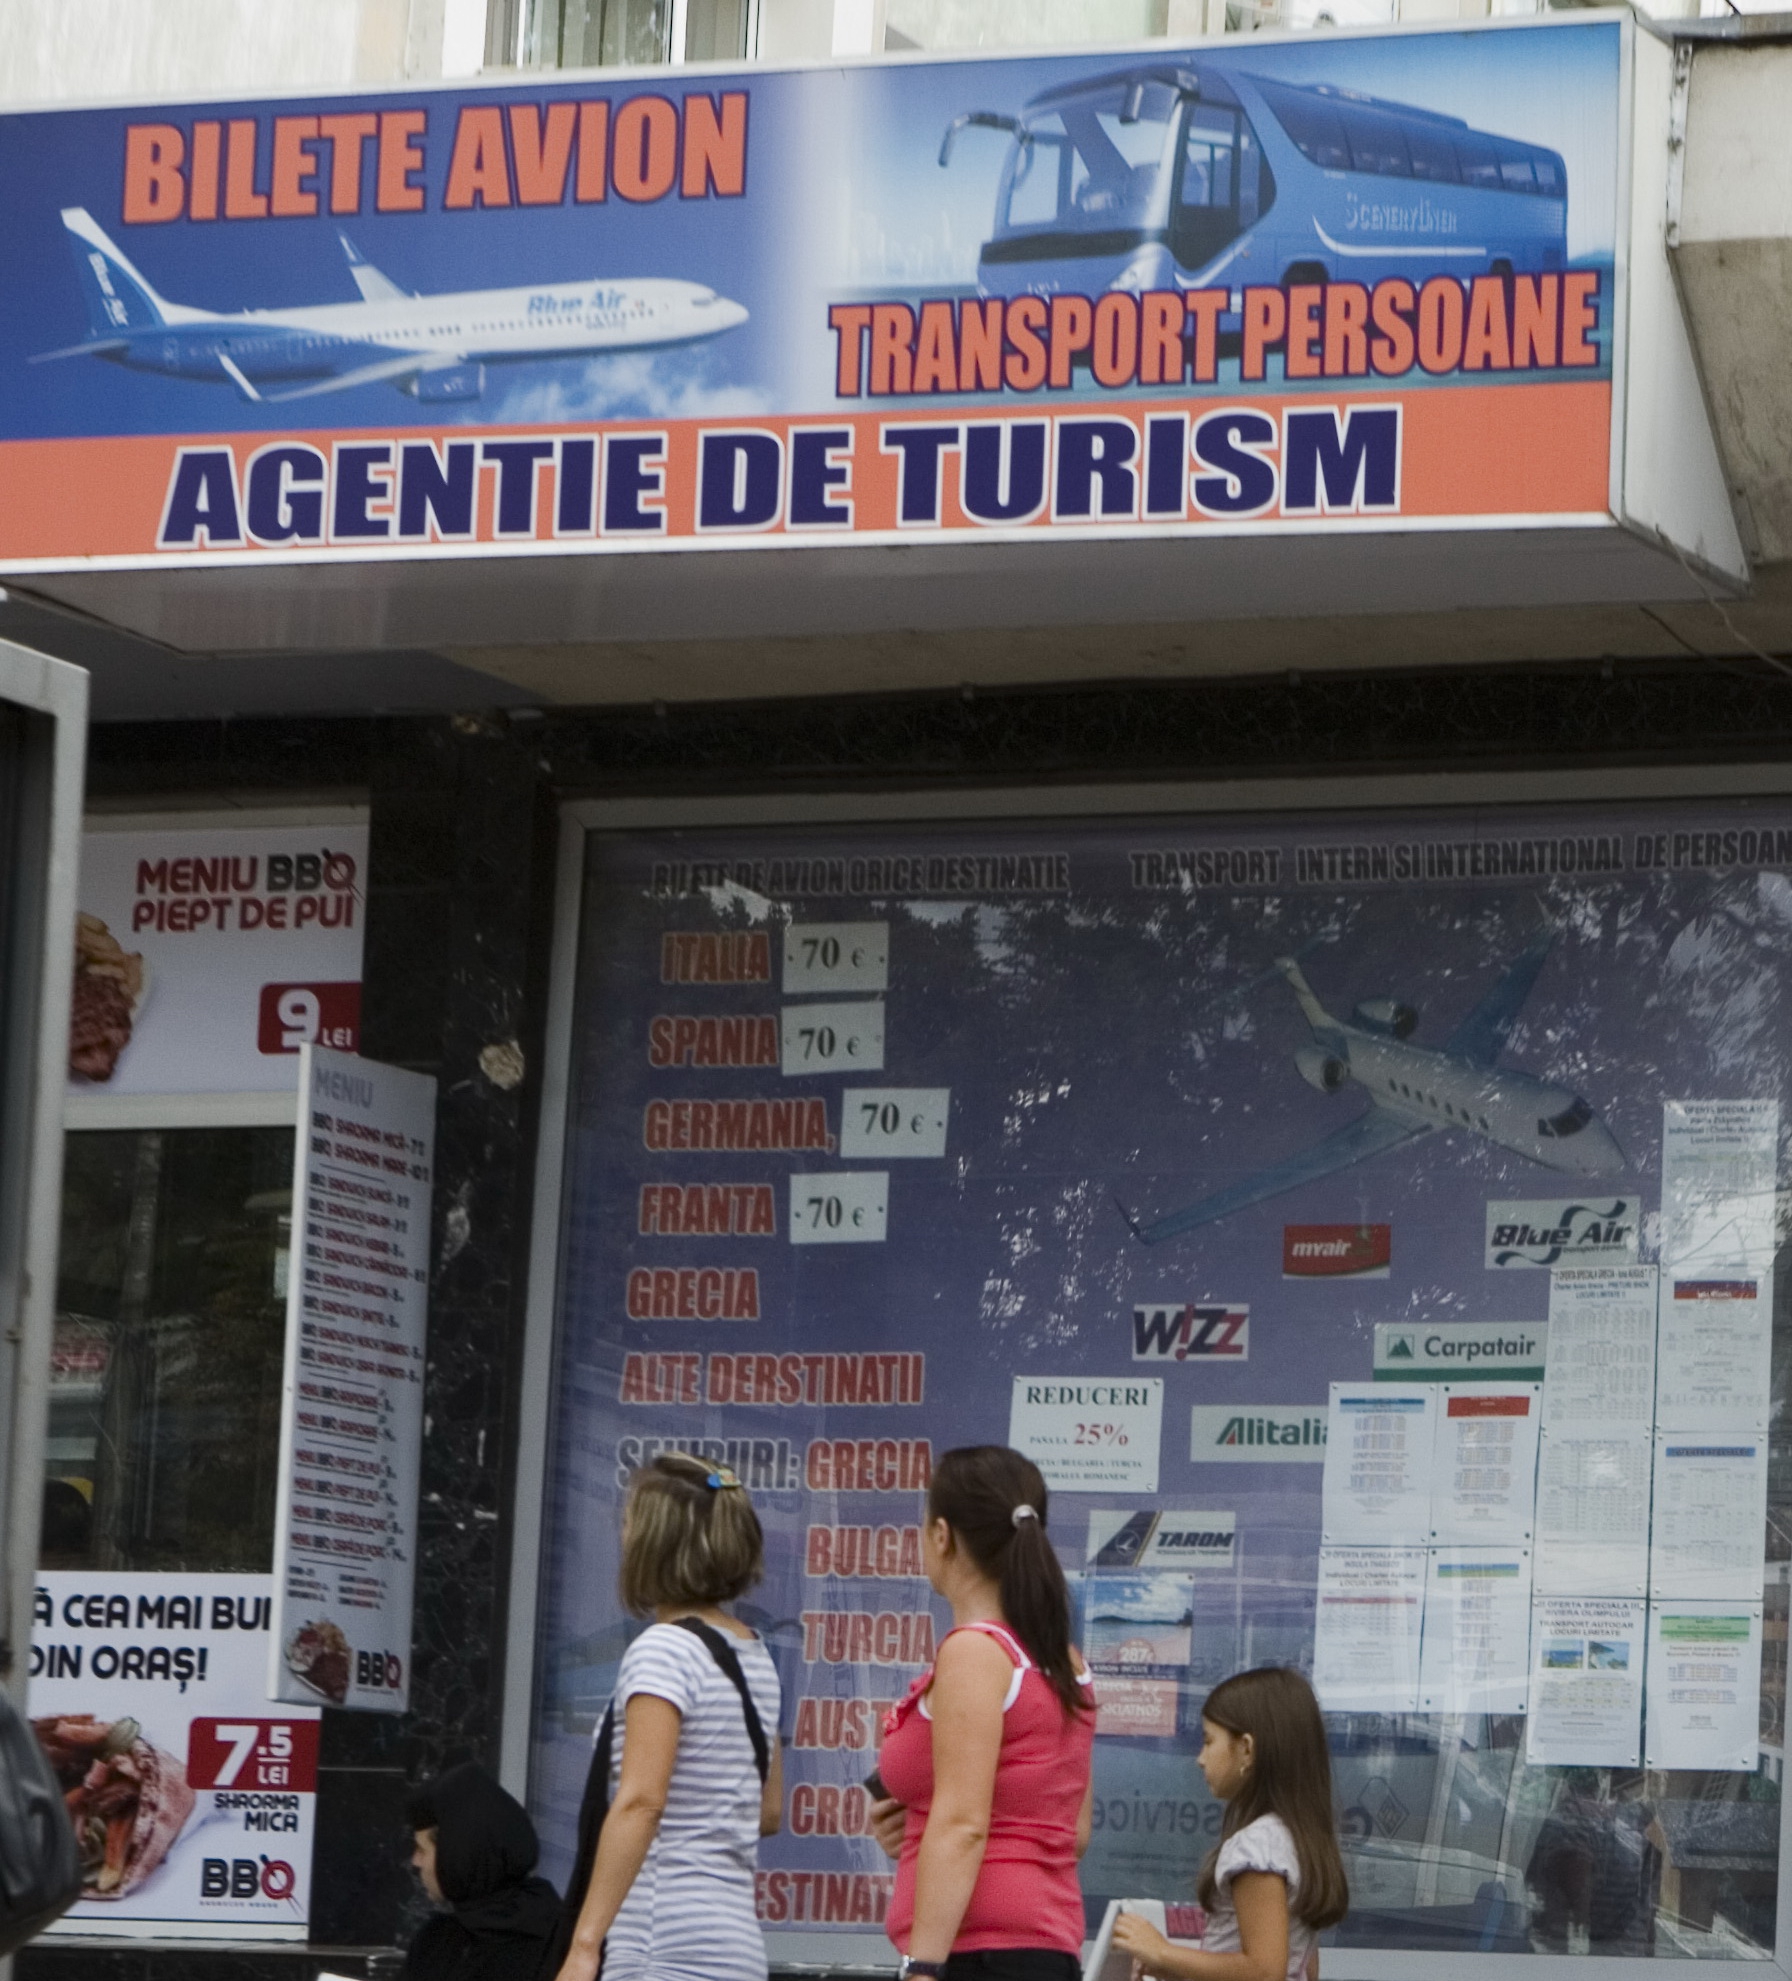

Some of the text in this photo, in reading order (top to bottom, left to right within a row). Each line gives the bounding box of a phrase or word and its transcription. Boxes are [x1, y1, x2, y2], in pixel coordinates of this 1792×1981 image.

[121, 91, 750, 227] BILETE AVION
[828, 270, 1602, 398] TRANSPORT PERSOANE
[155, 403, 1404, 550] AGENTIE DE TURISM
[136, 848, 358, 895] MENIU BBQ
[768, 857, 846, 896] AVION
[848, 855, 925, 895] ORICE
[926, 852, 1070, 892] DESTINATIE
[1129, 847, 1281, 888] TRANSPORT
[1297, 844, 1391, 883] INTERN
[1425, 835, 1624, 880] INTERNATIONAL
[1634, 832, 1669, 869] DE
[132, 896, 354, 932] PIEPT DE PUI
[661, 931, 771, 984] ITALIA
[801, 937, 841, 970] 70
[278, 988, 321, 1048] 9
[321, 1027, 353, 1047] LEI
[650, 1014, 779, 1067] SPANIA
[798, 1026, 837, 1060] 70
[860, 1102, 900, 1135] 70
[639, 1184, 775, 1235] FRANTA
[806, 1196, 843, 1229] 70
[1491, 1221, 1633, 1247] Blue Air
[626, 1268, 760, 1321] GRECIA
[1424, 1334, 1536, 1362] Carpatair
[620, 1352, 925, 1405] ALTE DERSTINATII
[1026, 1386, 1149, 1406] REDUCERI
[1074, 1422, 1129, 1446] 25%
[805, 1437, 932, 1491] GRECIA
[806, 1524, 926, 1577] BULGA
[1158, 1532, 1234, 1547] TAROM
[63, 1594, 131, 1629] CEA
[136, 1595, 203, 1630] MAI
[802, 1611, 936, 1666] TURCIA
[357, 1650, 402, 1689] BBQ
[257, 1765, 290, 1785] LEI
[789, 1783, 873, 1837] CRO
[201, 1855, 296, 1900] BBQ
